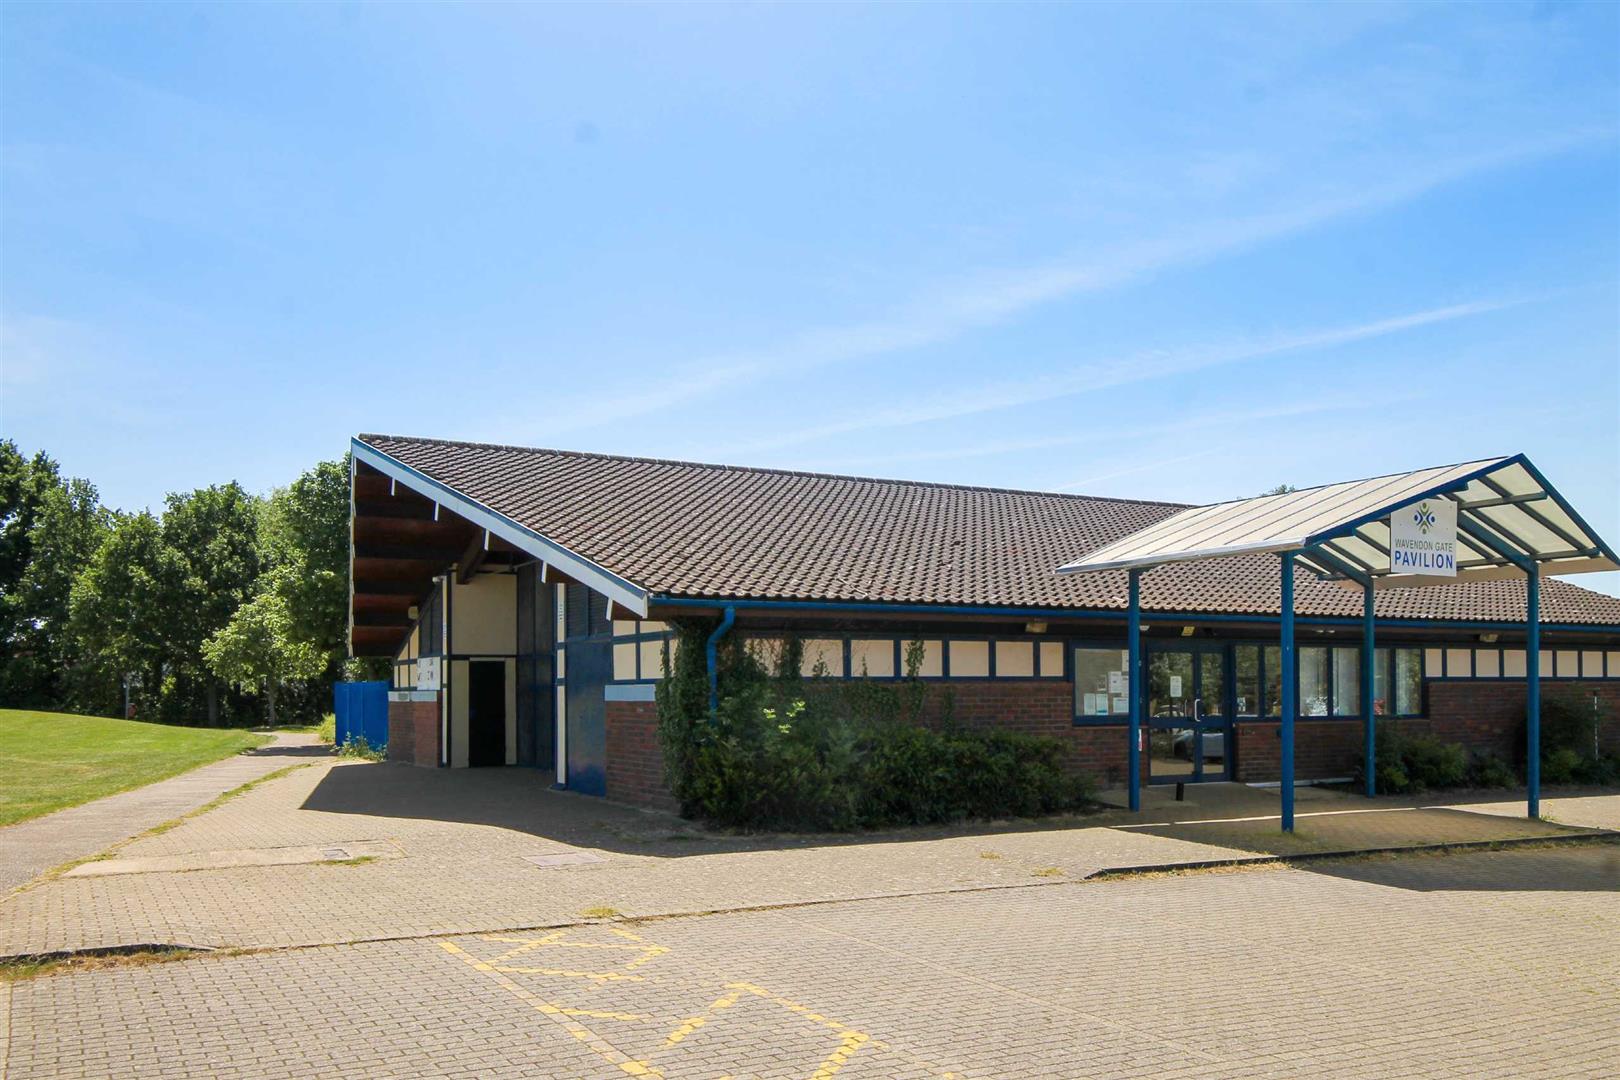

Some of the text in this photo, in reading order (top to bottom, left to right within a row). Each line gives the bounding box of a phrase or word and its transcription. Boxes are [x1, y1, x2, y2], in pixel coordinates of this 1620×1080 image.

[1395, 538, 1453, 552] WAVENDON GATE
[1394, 551, 1453, 569] PAVILION
